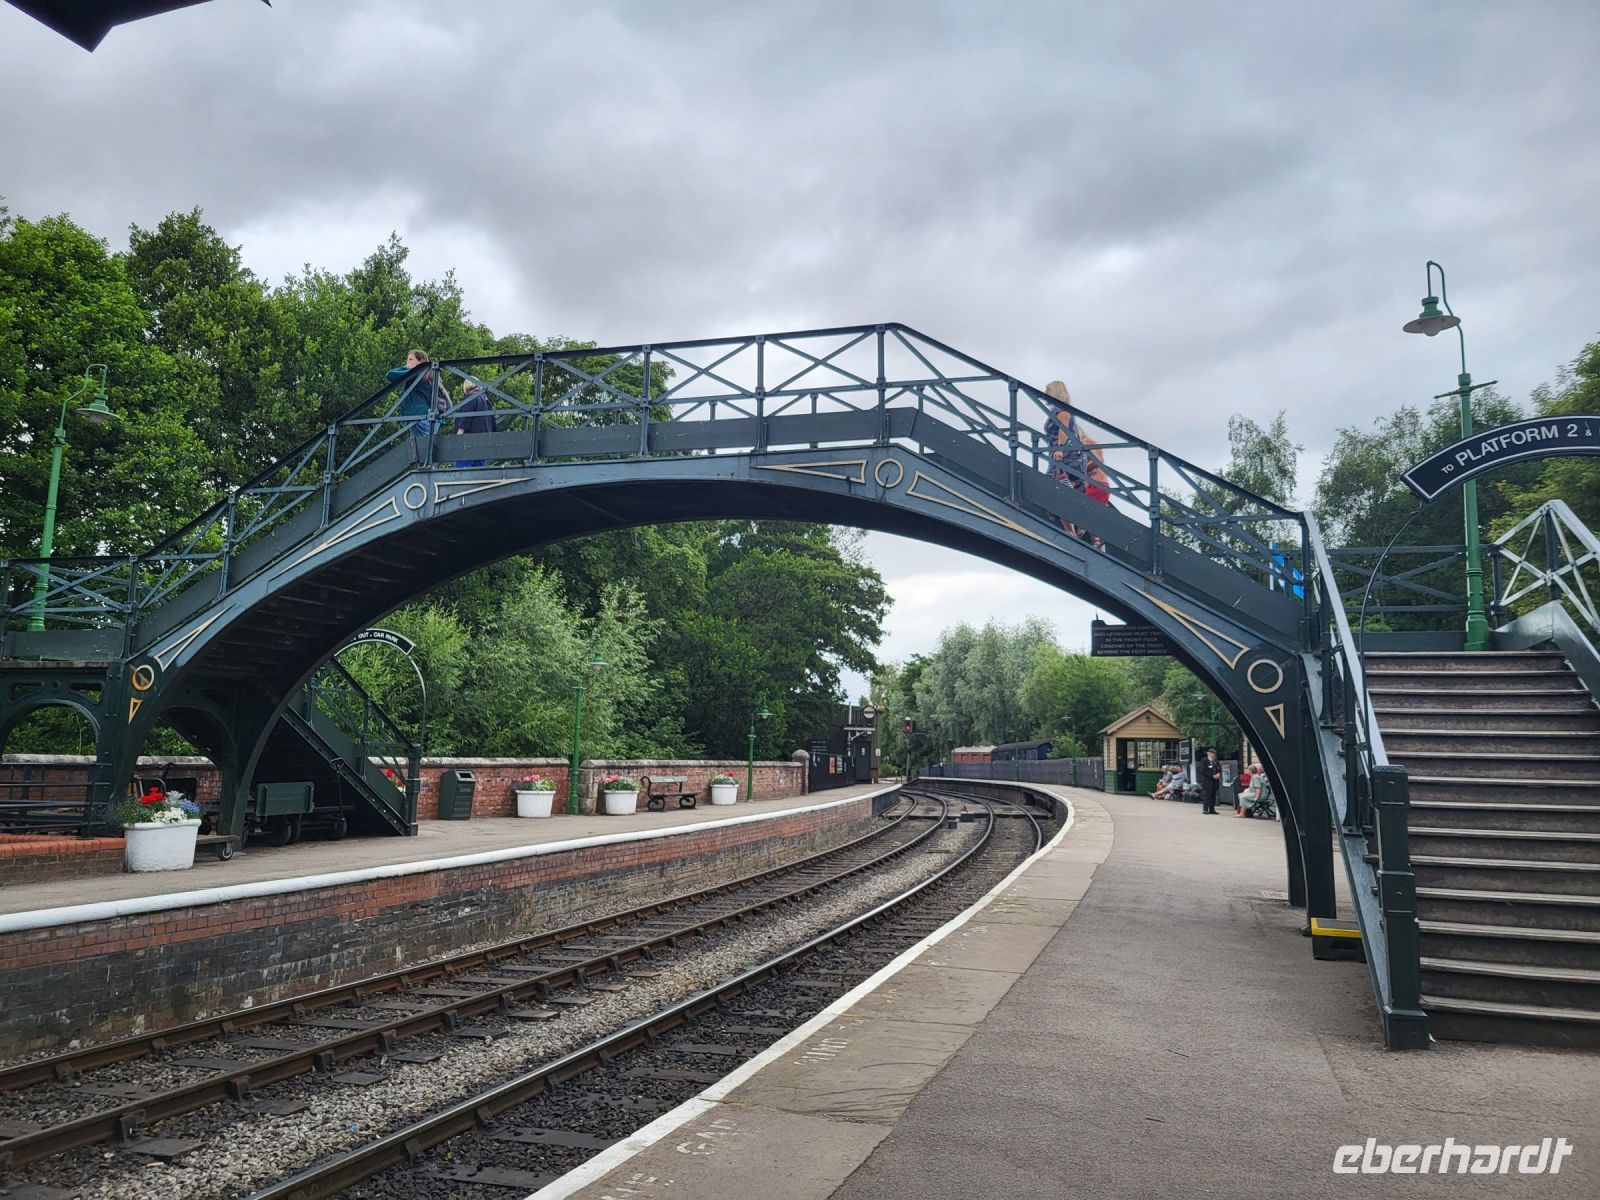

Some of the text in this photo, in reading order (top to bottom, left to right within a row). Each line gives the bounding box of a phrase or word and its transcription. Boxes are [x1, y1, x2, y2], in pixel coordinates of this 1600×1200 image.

[1441, 463, 1455, 474] TO
[1455, 424, 1559, 467] PLATFORM
[1567, 423, 1578, 437] 2
[358, 631, 370, 639] OUT
[373, 631, 385, 639] CAR
[385, 634, 399, 644] PARK
